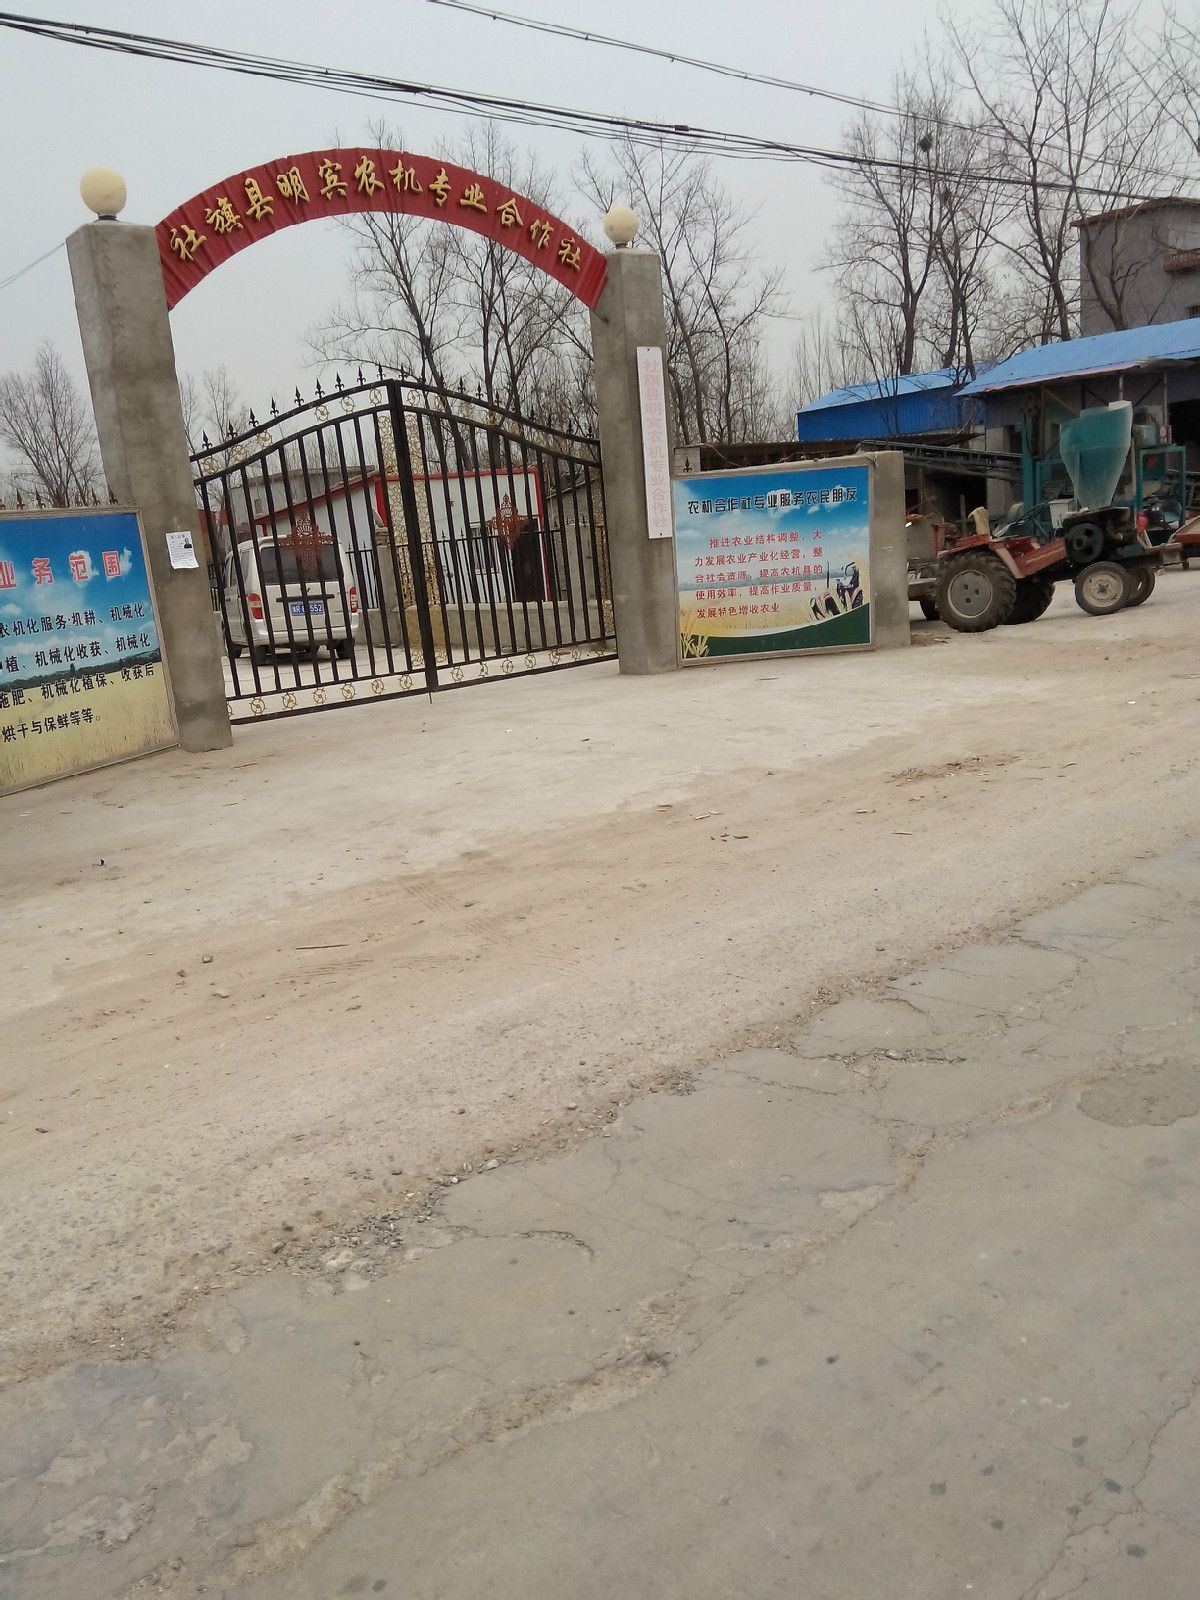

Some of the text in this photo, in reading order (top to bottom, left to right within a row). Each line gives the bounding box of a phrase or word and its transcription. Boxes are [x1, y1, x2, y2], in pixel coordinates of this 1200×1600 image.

[170, 155, 582, 272] 社旗县明宾农机专业合作社
[688, 487, 857, 515] 农机合作社专业服务农民朋友
[0, 551, 121, 588] 业务范围
[697, 602, 780, 619] 发展特色增收农业
[0, 633, 151, 674] 植、机械化收获、机械化
